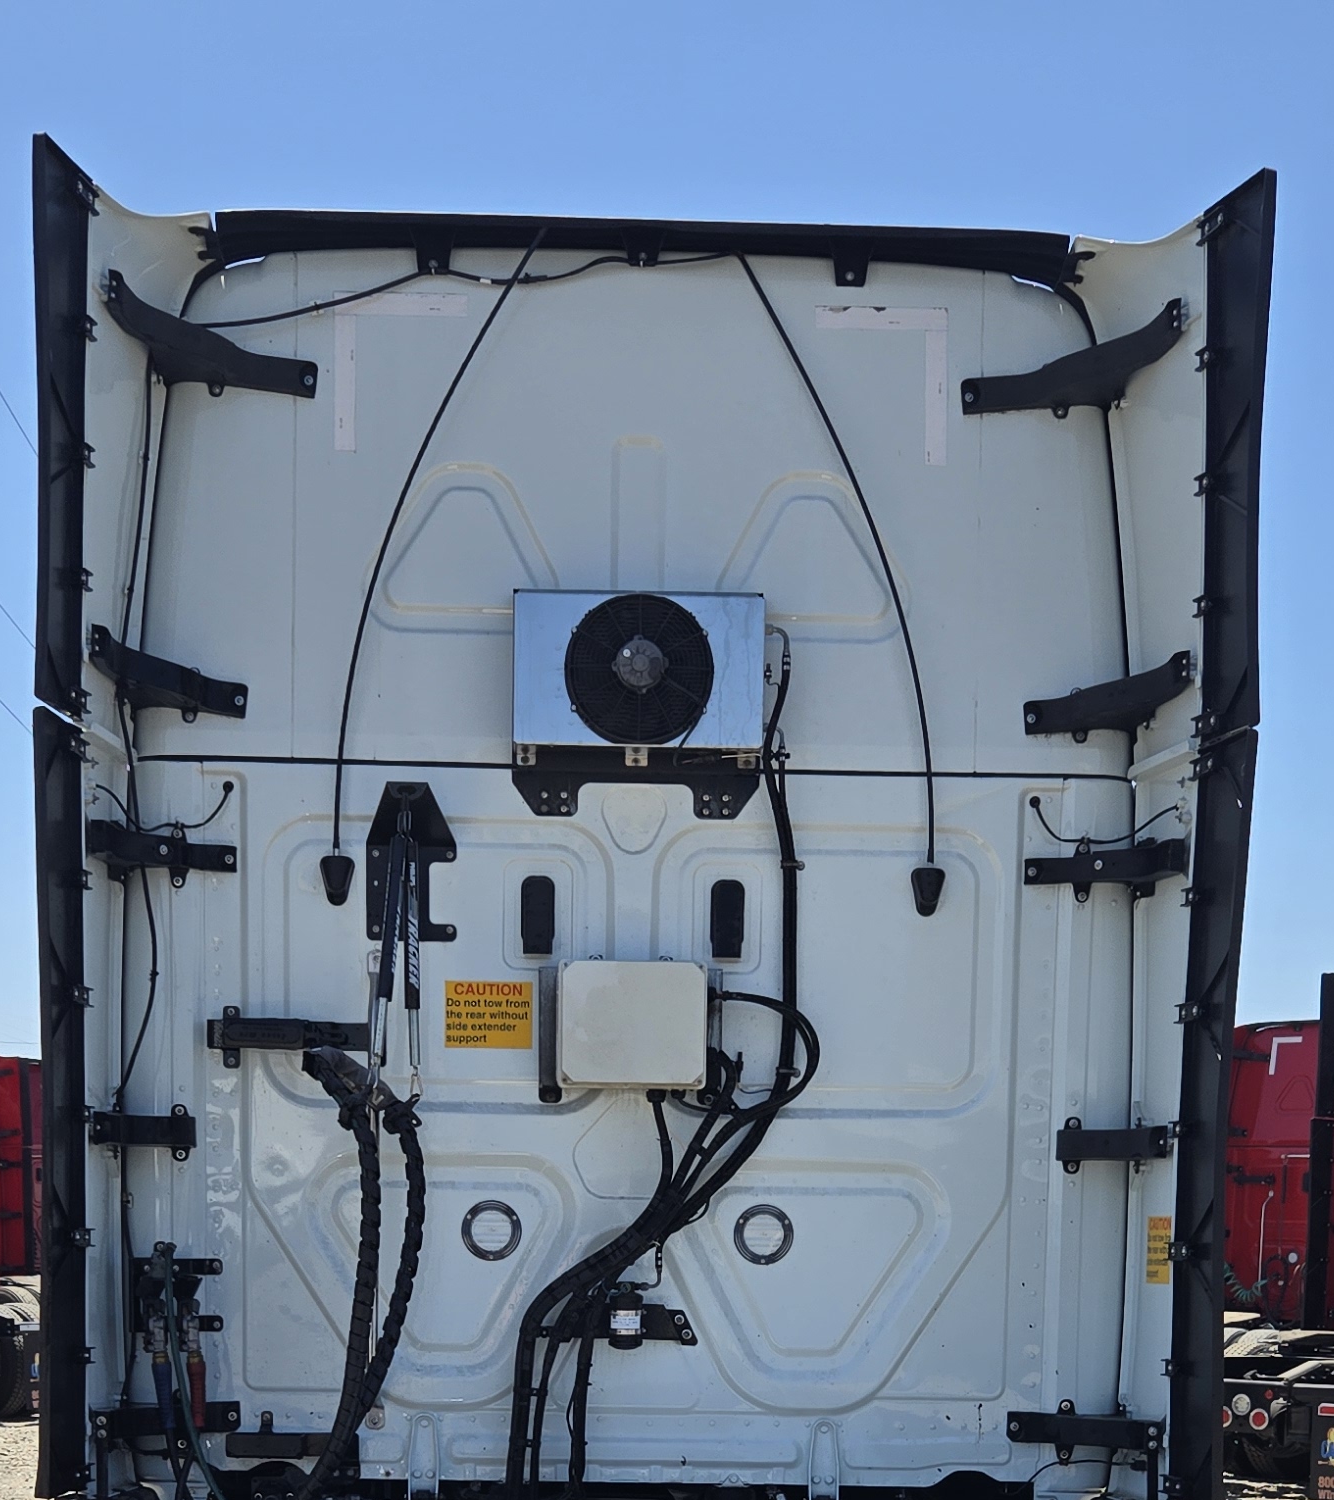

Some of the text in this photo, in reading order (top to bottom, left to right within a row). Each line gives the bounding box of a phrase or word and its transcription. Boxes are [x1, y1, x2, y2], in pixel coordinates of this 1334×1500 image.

[454, 983, 523, 996] CAUTION
[447, 998, 530, 1008] Do not tow from
[446, 1010, 462, 1019] the
[489, 1011, 528, 1020] without
[446, 1022, 517, 1032] side extender
[446, 1034, 487, 1044] support
